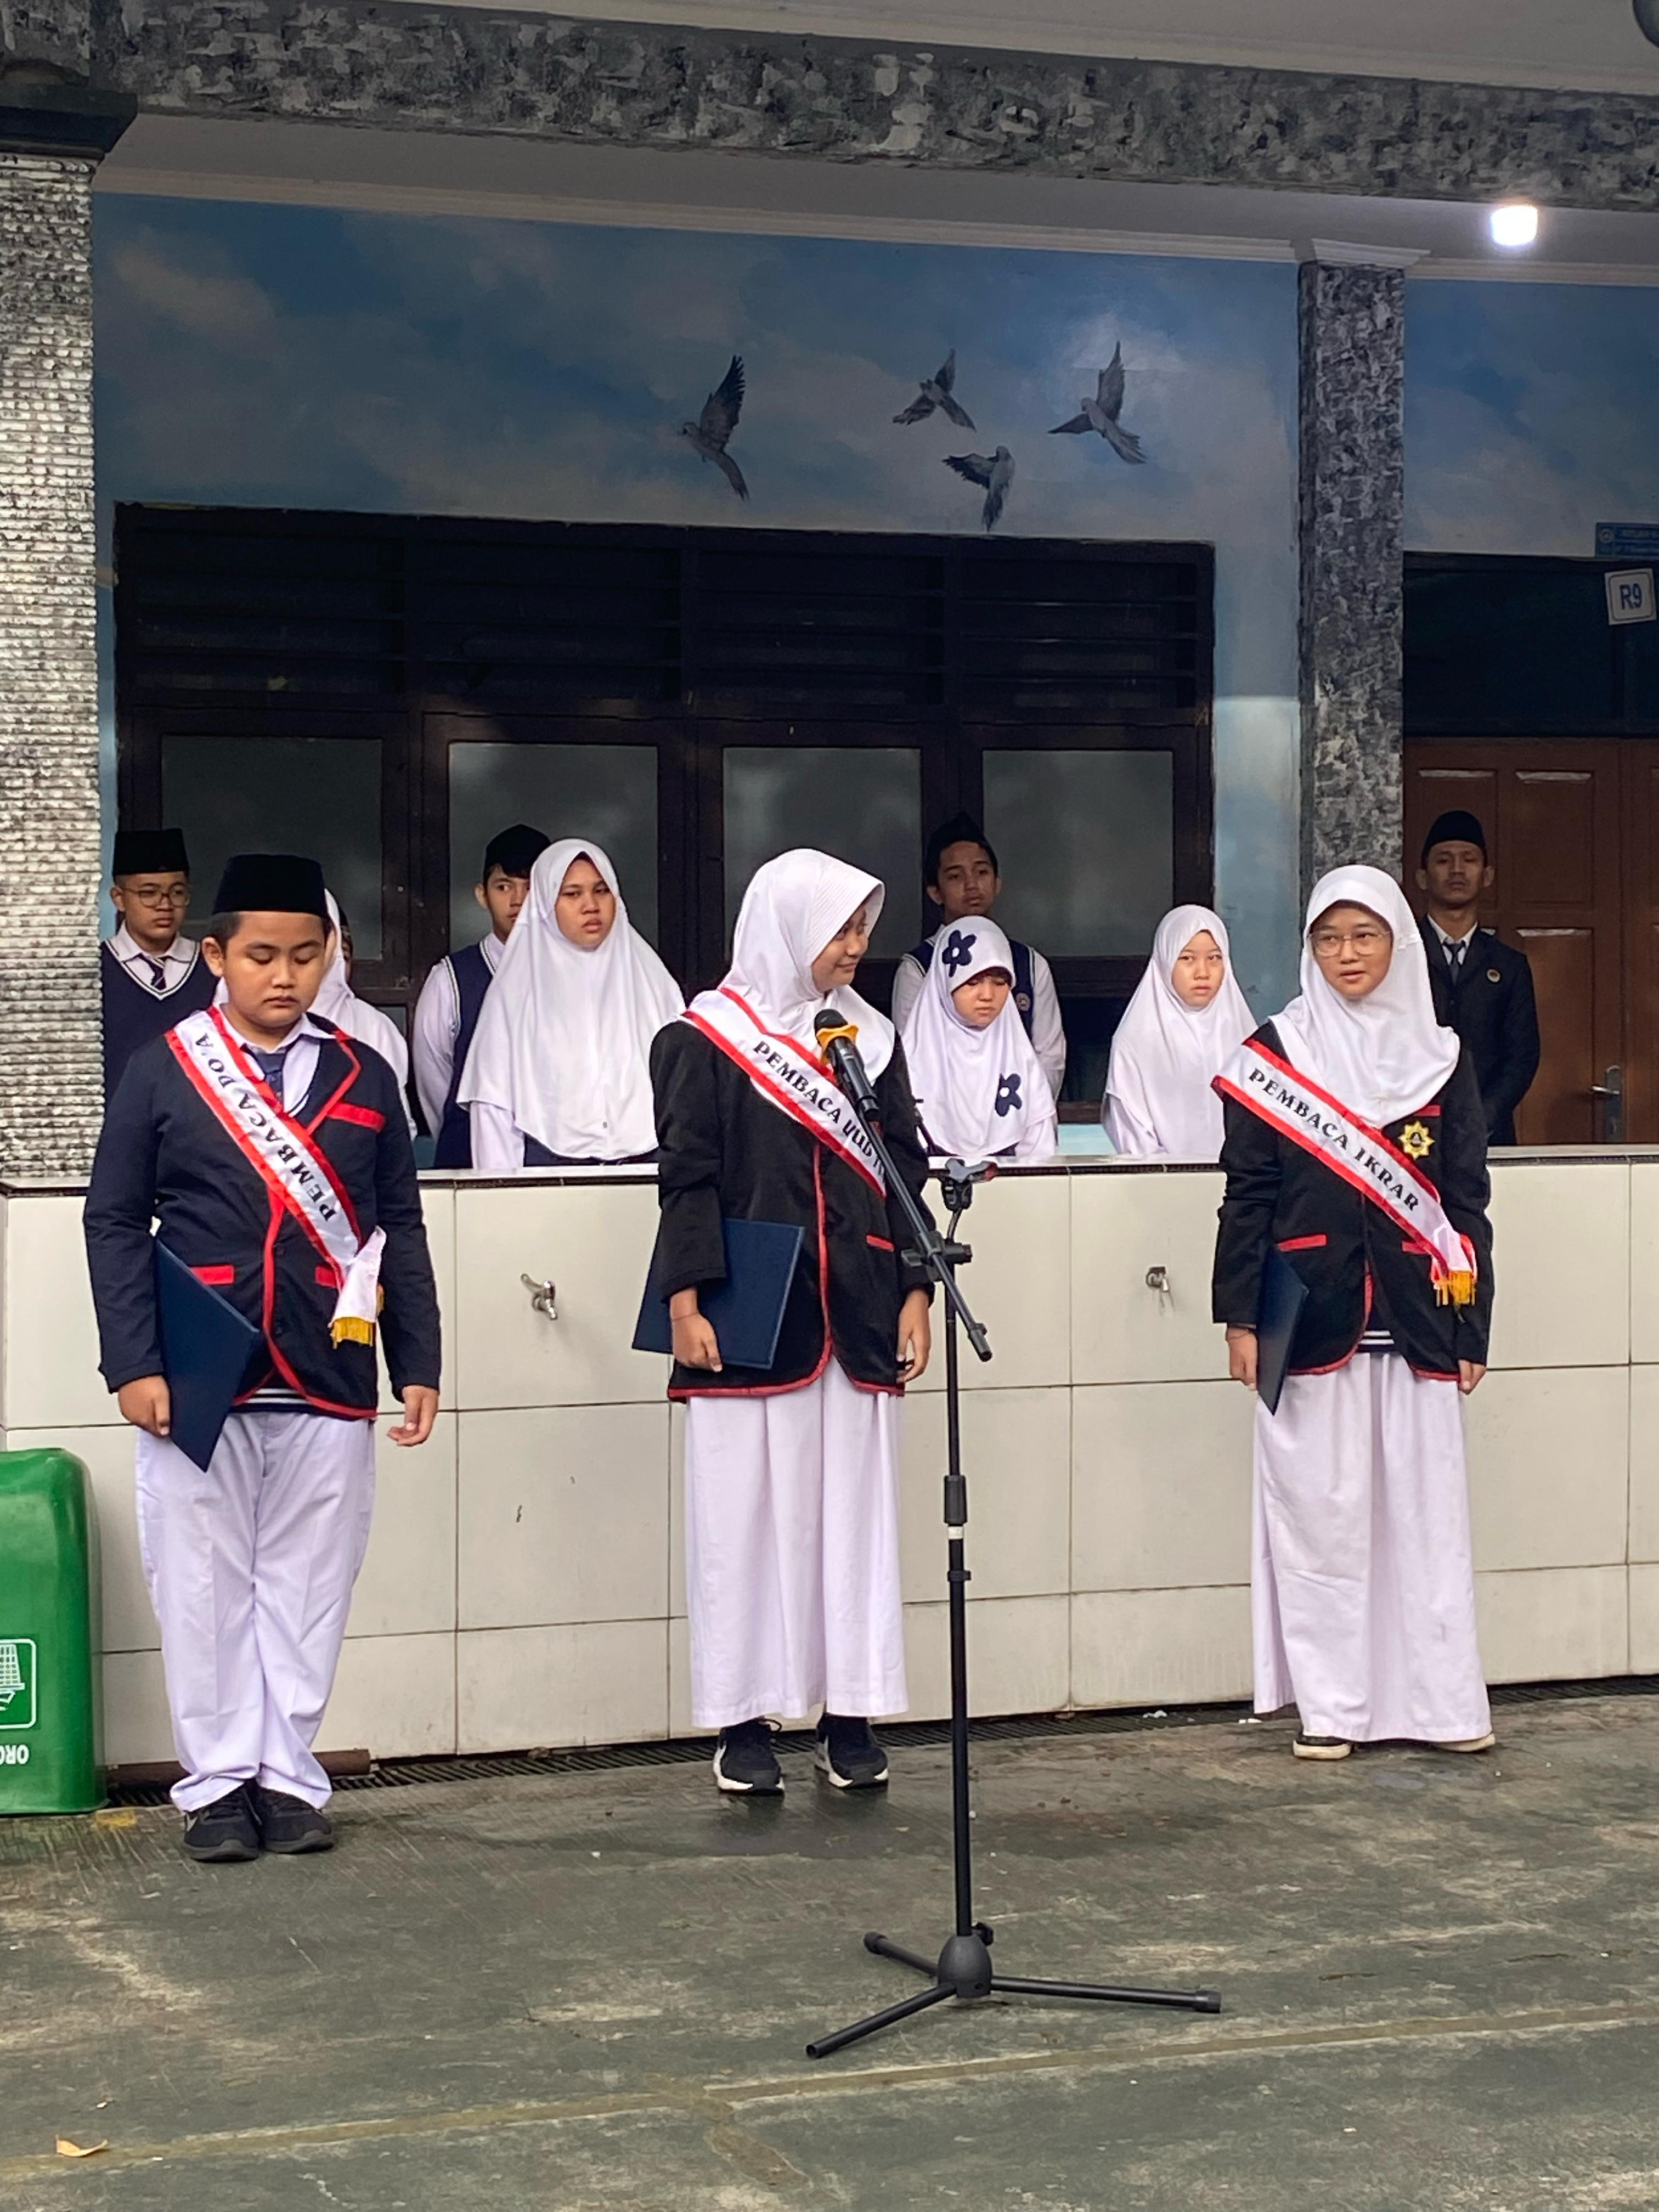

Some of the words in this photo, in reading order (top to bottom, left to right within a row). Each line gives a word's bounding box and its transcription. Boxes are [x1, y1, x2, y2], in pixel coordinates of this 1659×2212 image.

[1620, 583, 1643, 611] R9
[753, 1040, 841, 1124] PEMBACA
[237, 1093, 337, 1222] PEMBACA
[1248, 1067, 1348, 1150] PEMBACA
[1353, 1148, 1420, 1212] IKRAR
